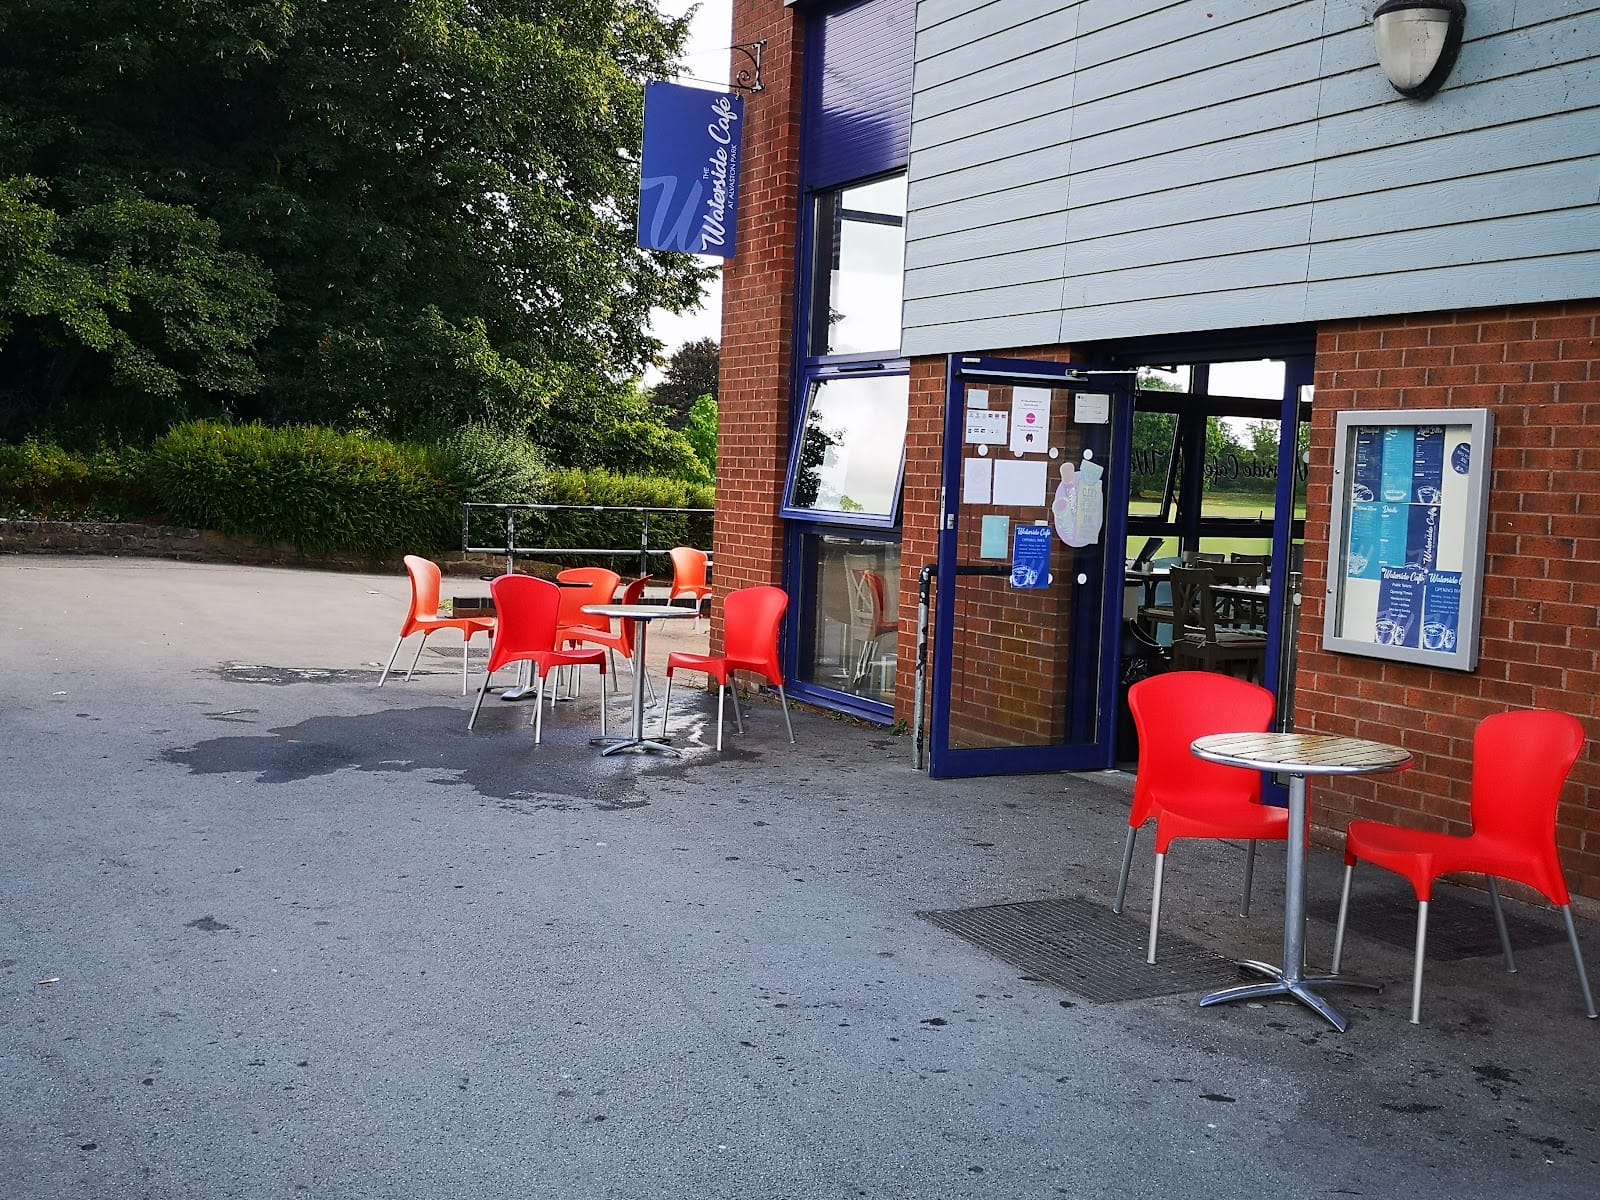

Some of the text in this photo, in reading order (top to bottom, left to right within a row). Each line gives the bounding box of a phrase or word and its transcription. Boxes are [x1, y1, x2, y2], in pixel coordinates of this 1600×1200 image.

[701, 96, 738, 251] Waterside Café
[728, 145, 738, 210] AT ALVASTON PARK
[1422, 525, 1434, 565] Waterside
[1384, 570, 1410, 580] Waterside
[1428, 573, 1459, 584] Waterside
